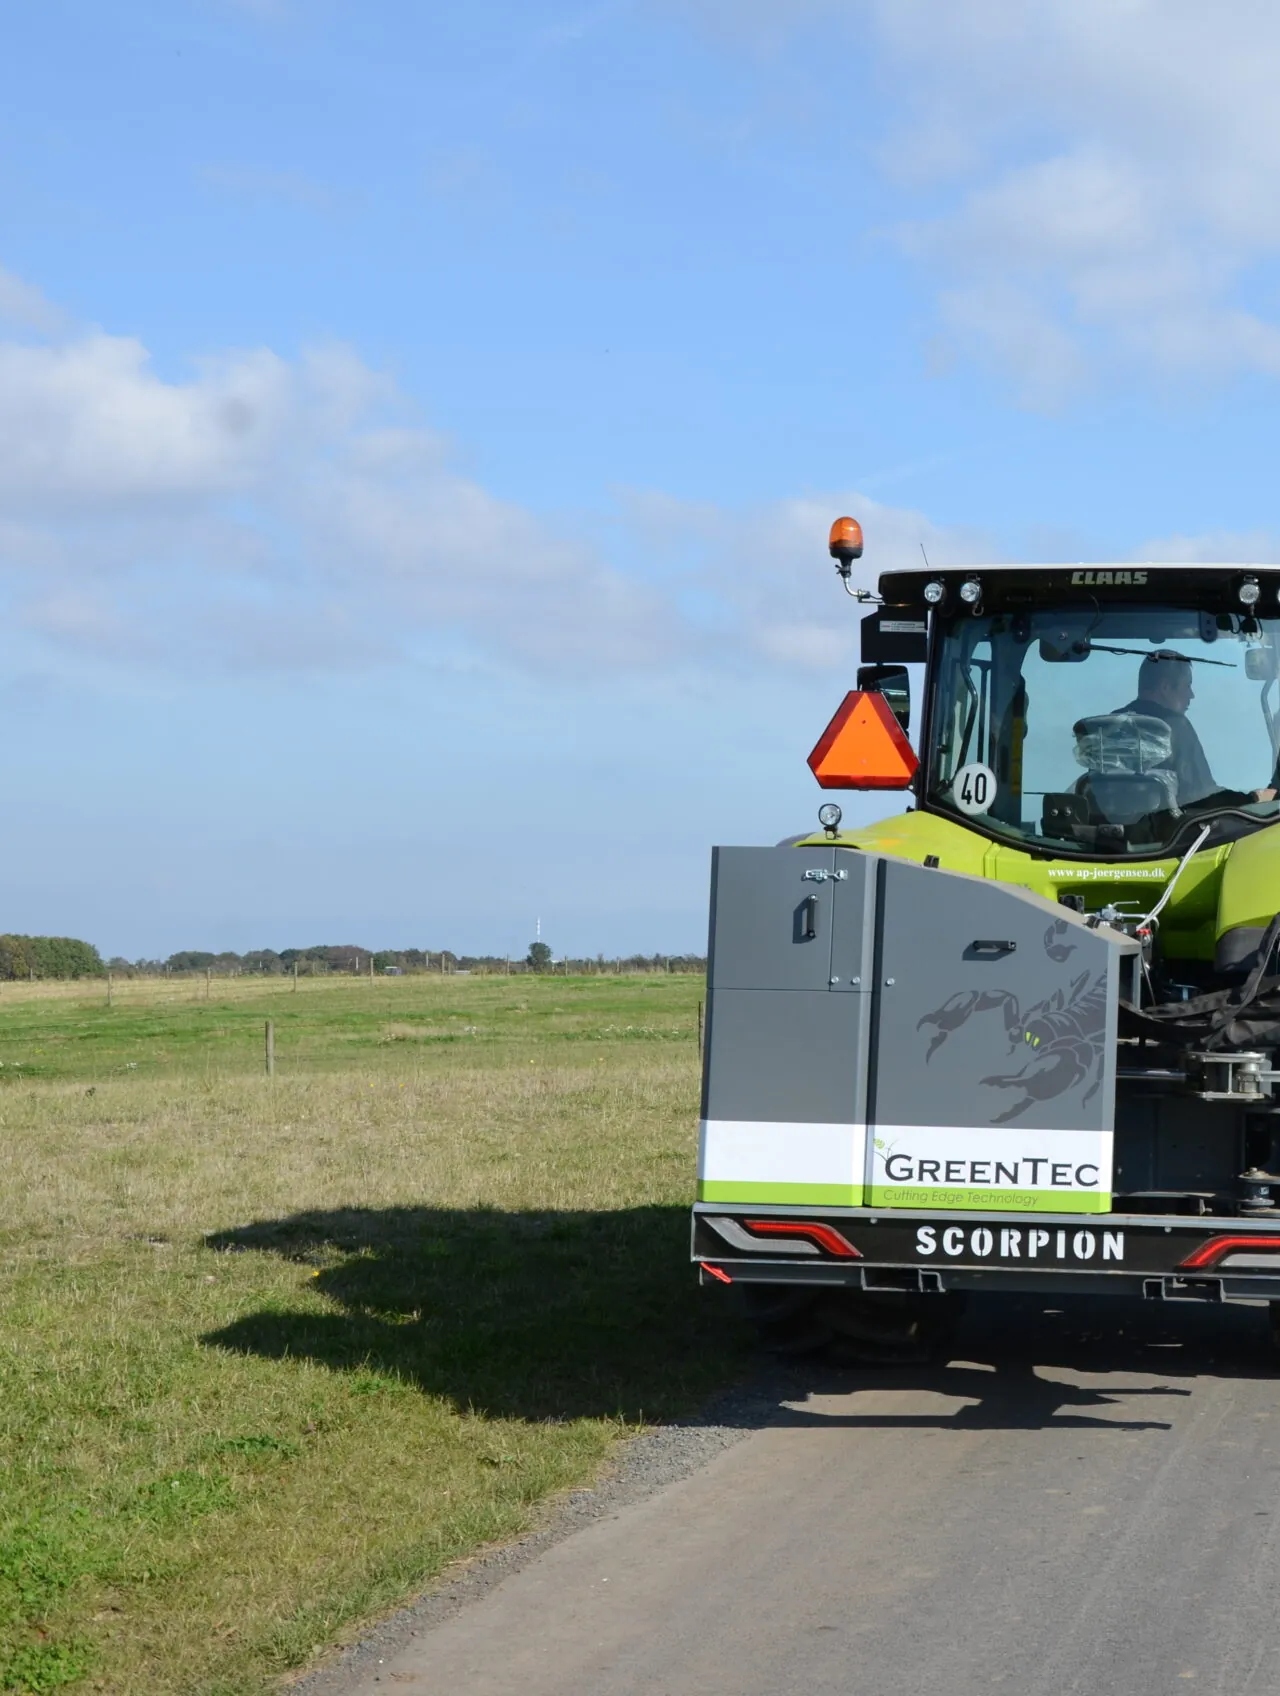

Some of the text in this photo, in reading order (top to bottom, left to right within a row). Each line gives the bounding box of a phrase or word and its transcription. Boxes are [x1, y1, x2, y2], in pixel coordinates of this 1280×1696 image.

[1071, 571, 1149, 585] CLAAS
[961, 772, 987, 805] 40
[1048, 868, 1165, 880] wwwap-joergensen.dk
[883, 1189, 1039, 1207] Cutting Edge Technology
[916, 1226, 1125, 1260] SCORPION
